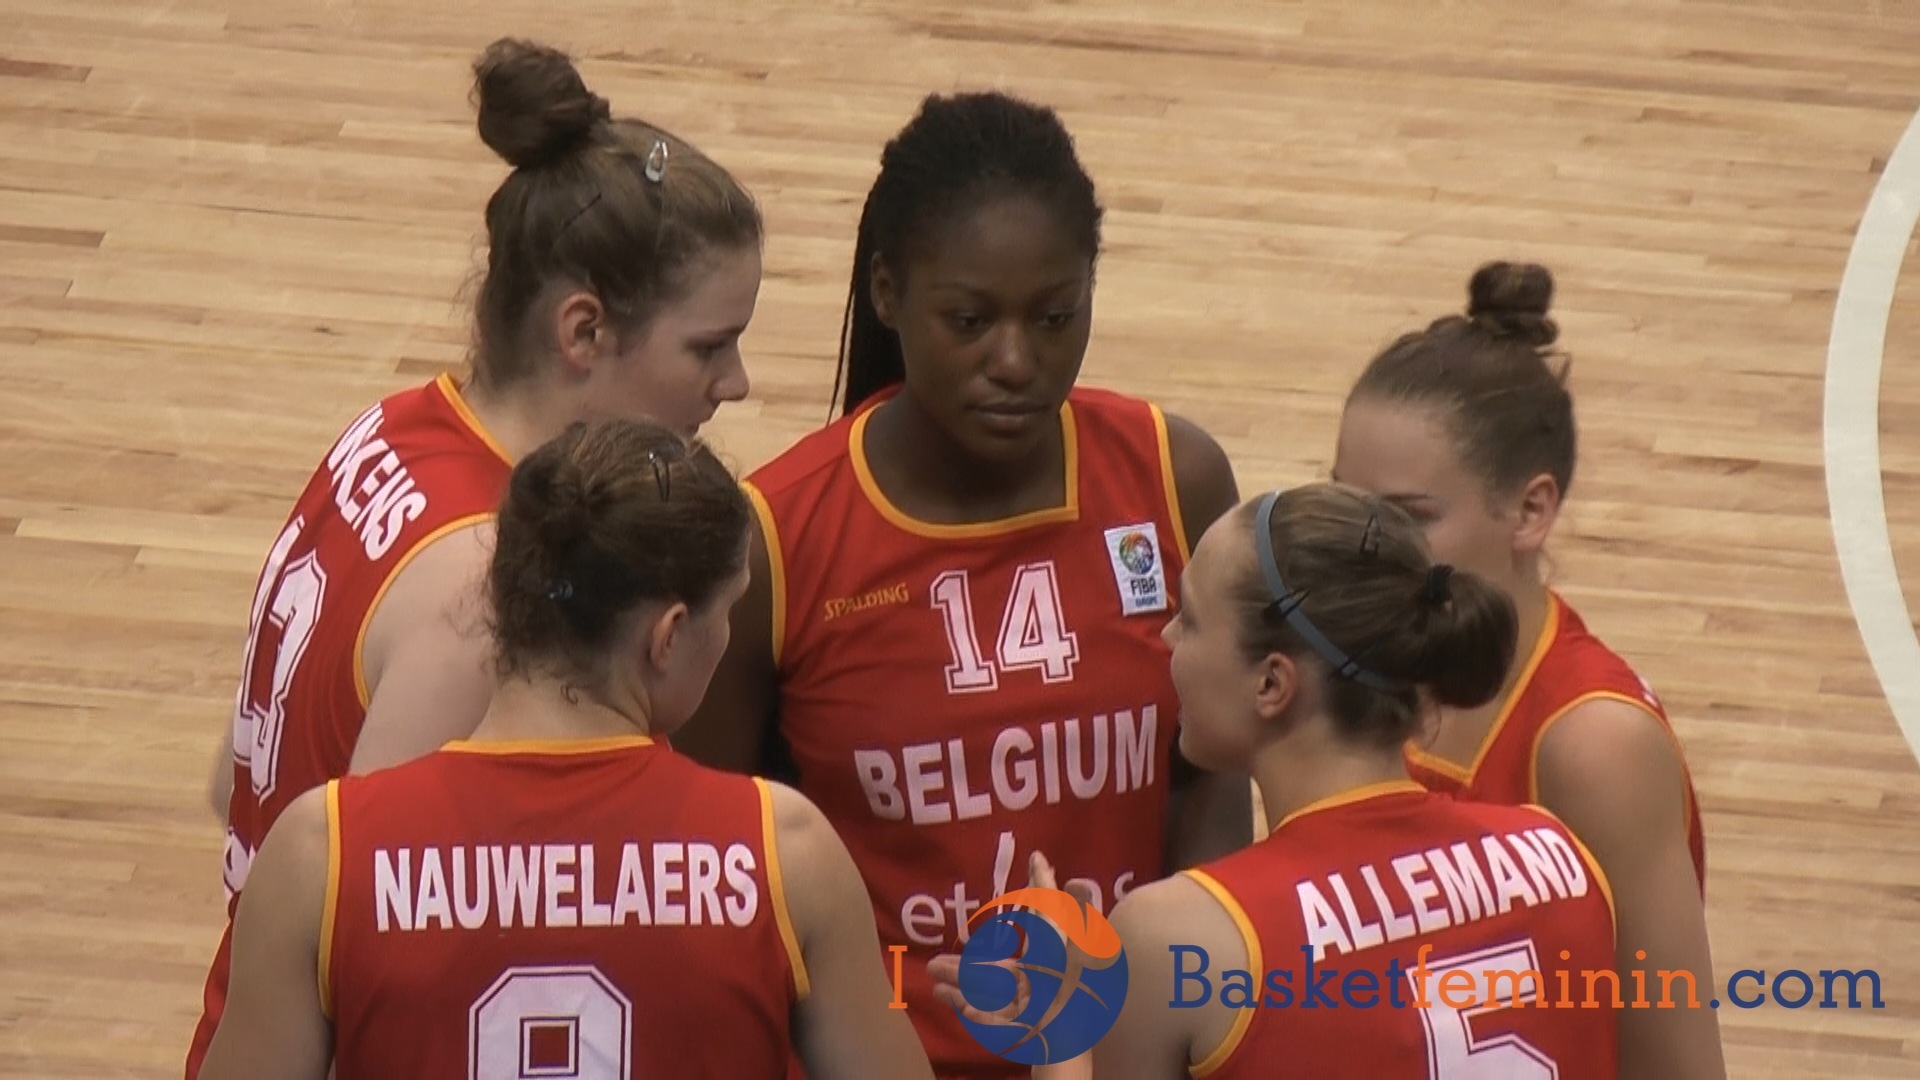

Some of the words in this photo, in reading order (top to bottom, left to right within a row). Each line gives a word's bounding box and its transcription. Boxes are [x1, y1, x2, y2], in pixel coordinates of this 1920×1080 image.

[825, 582, 909, 621] SPALDING
[930, 560, 1080, 694] 14
[1130, 577, 1157, 596] FIBA
[854, 704, 1157, 825] BELGIUM
[374, 842, 758, 932] NAUWELAERS
[1296, 828, 1588, 963] ALLEMAND
[1405, 938, 1560, 1080] 5
